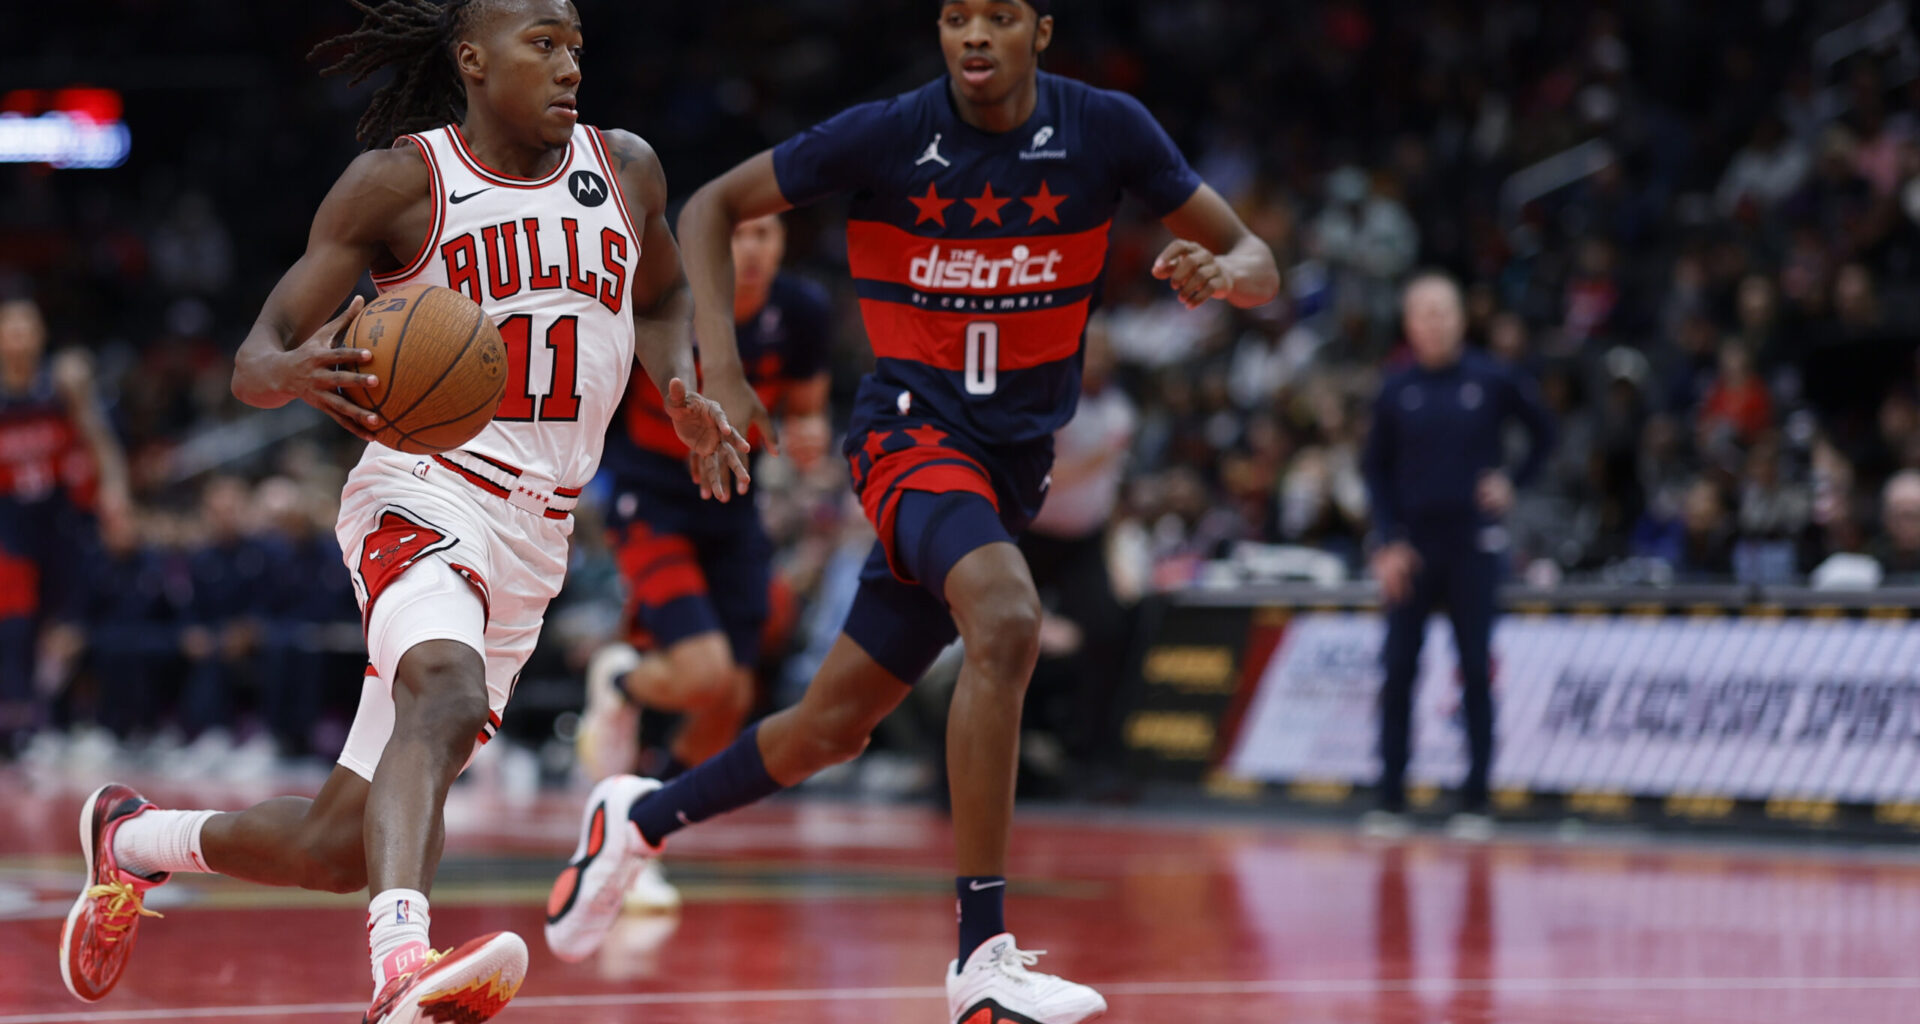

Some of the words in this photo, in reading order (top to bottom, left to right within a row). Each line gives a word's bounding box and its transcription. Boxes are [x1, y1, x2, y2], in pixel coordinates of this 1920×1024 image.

[440, 217, 628, 315] BULLS
[909, 244, 1063, 288] district
[950, 249, 977, 261] THE
[492, 313, 582, 422] 11
[964, 321, 999, 396] 0
